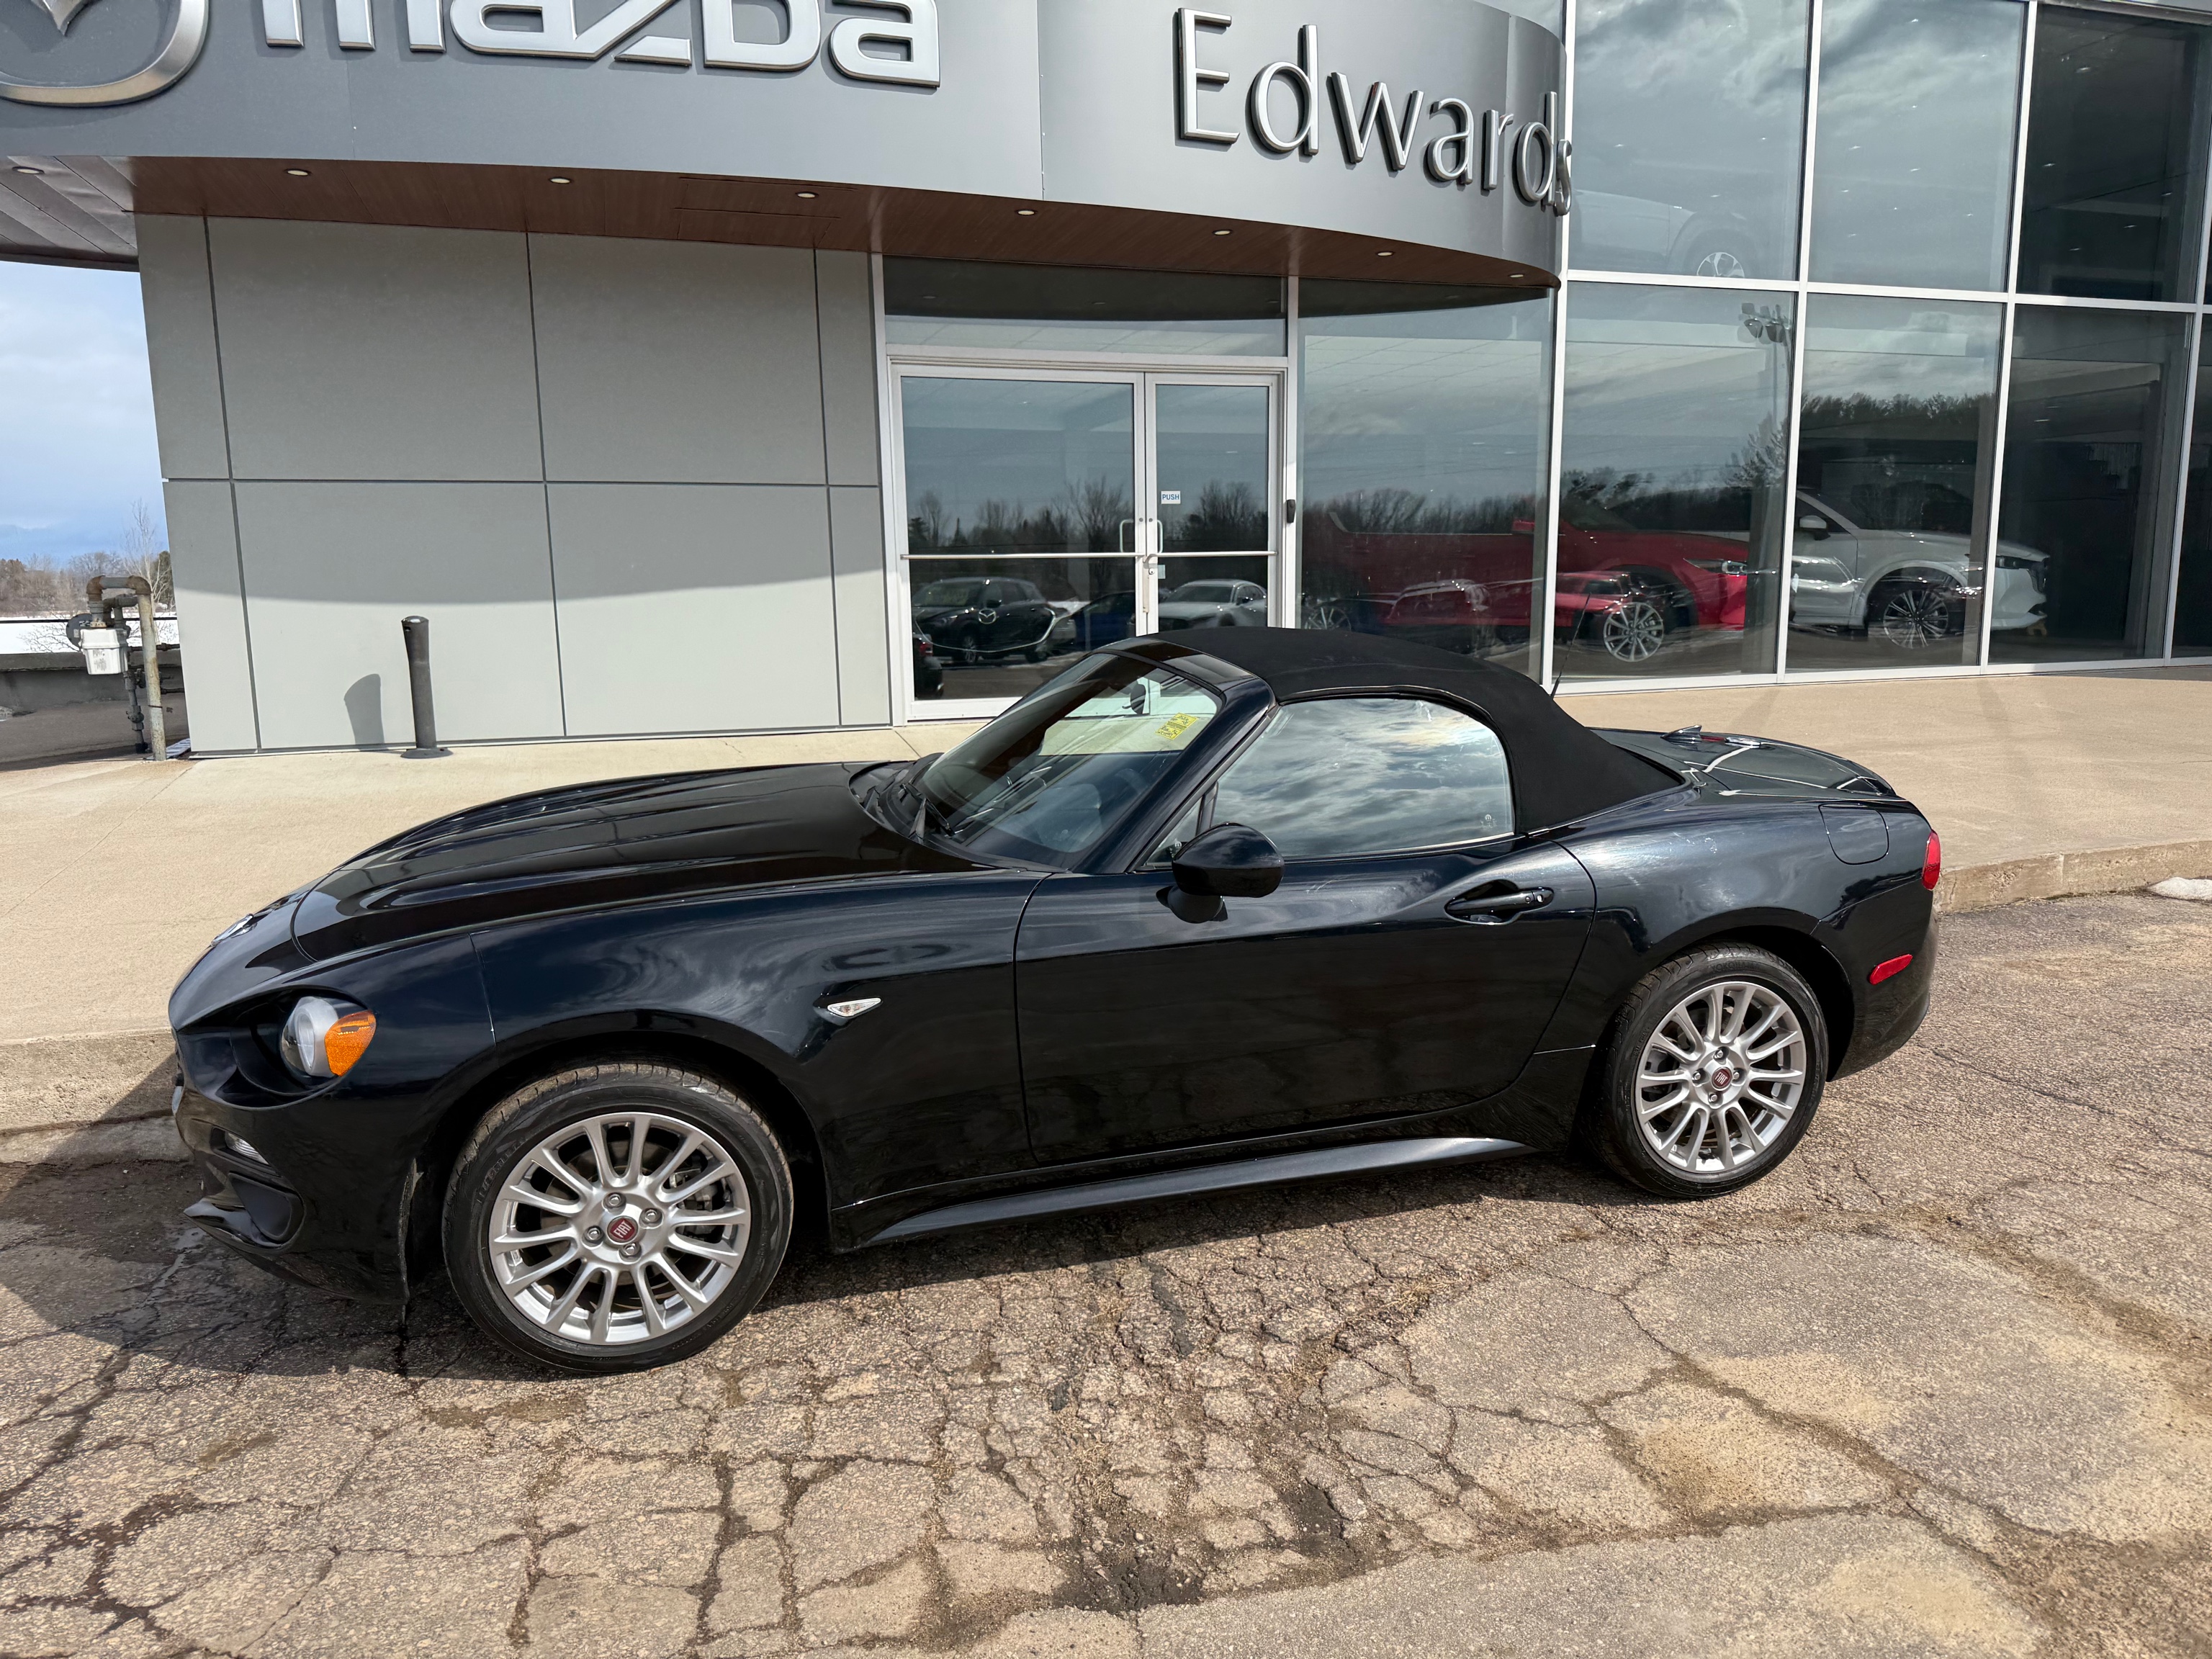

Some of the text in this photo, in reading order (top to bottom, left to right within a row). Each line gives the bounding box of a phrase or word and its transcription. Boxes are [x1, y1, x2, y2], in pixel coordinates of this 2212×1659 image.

[1179, 8, 1572, 216] Edwards
[1714, 1071, 1728, 1085] FIAT
[613, 1220, 632, 1238] FIAT
